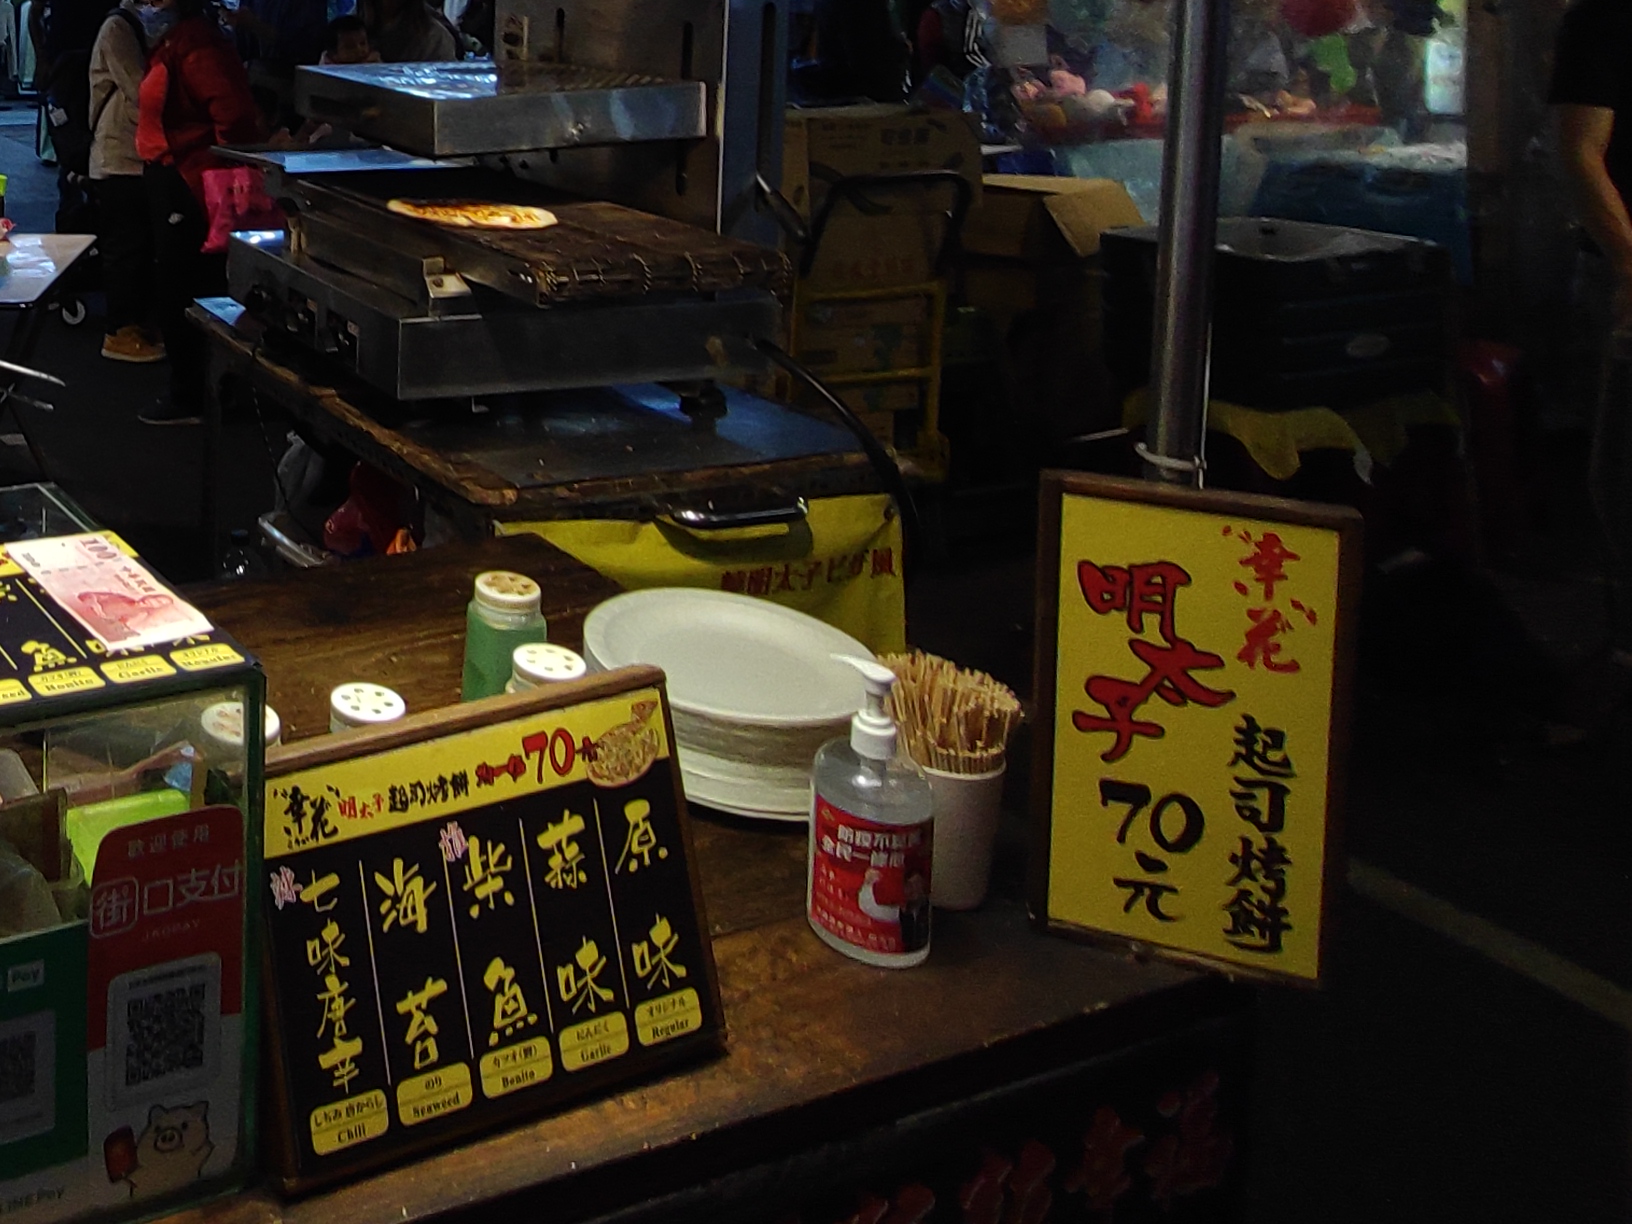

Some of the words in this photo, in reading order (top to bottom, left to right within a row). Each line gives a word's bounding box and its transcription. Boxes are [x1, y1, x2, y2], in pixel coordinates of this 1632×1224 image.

[1072, 559, 1237, 762] 明太子
[1222, 713, 1298, 954] 起司烤餅
[92, 858, 244, 932] 街口支付
[536, 809, 615, 1015] 蒜味
[615, 798, 688, 990] 原味
[9, 963, 43, 988] Pay
[374, 858, 448, 1069] 海苔
[463, 835, 538, 1046] 柴魚
[580, 1044, 612, 1063] Garlic
[651, 1017, 690, 1040] Regular
[412, 1091, 461, 1119] Seaweed
[501, 1068, 536, 1089] Bonito
[336, 1122, 367, 1144] Chili
